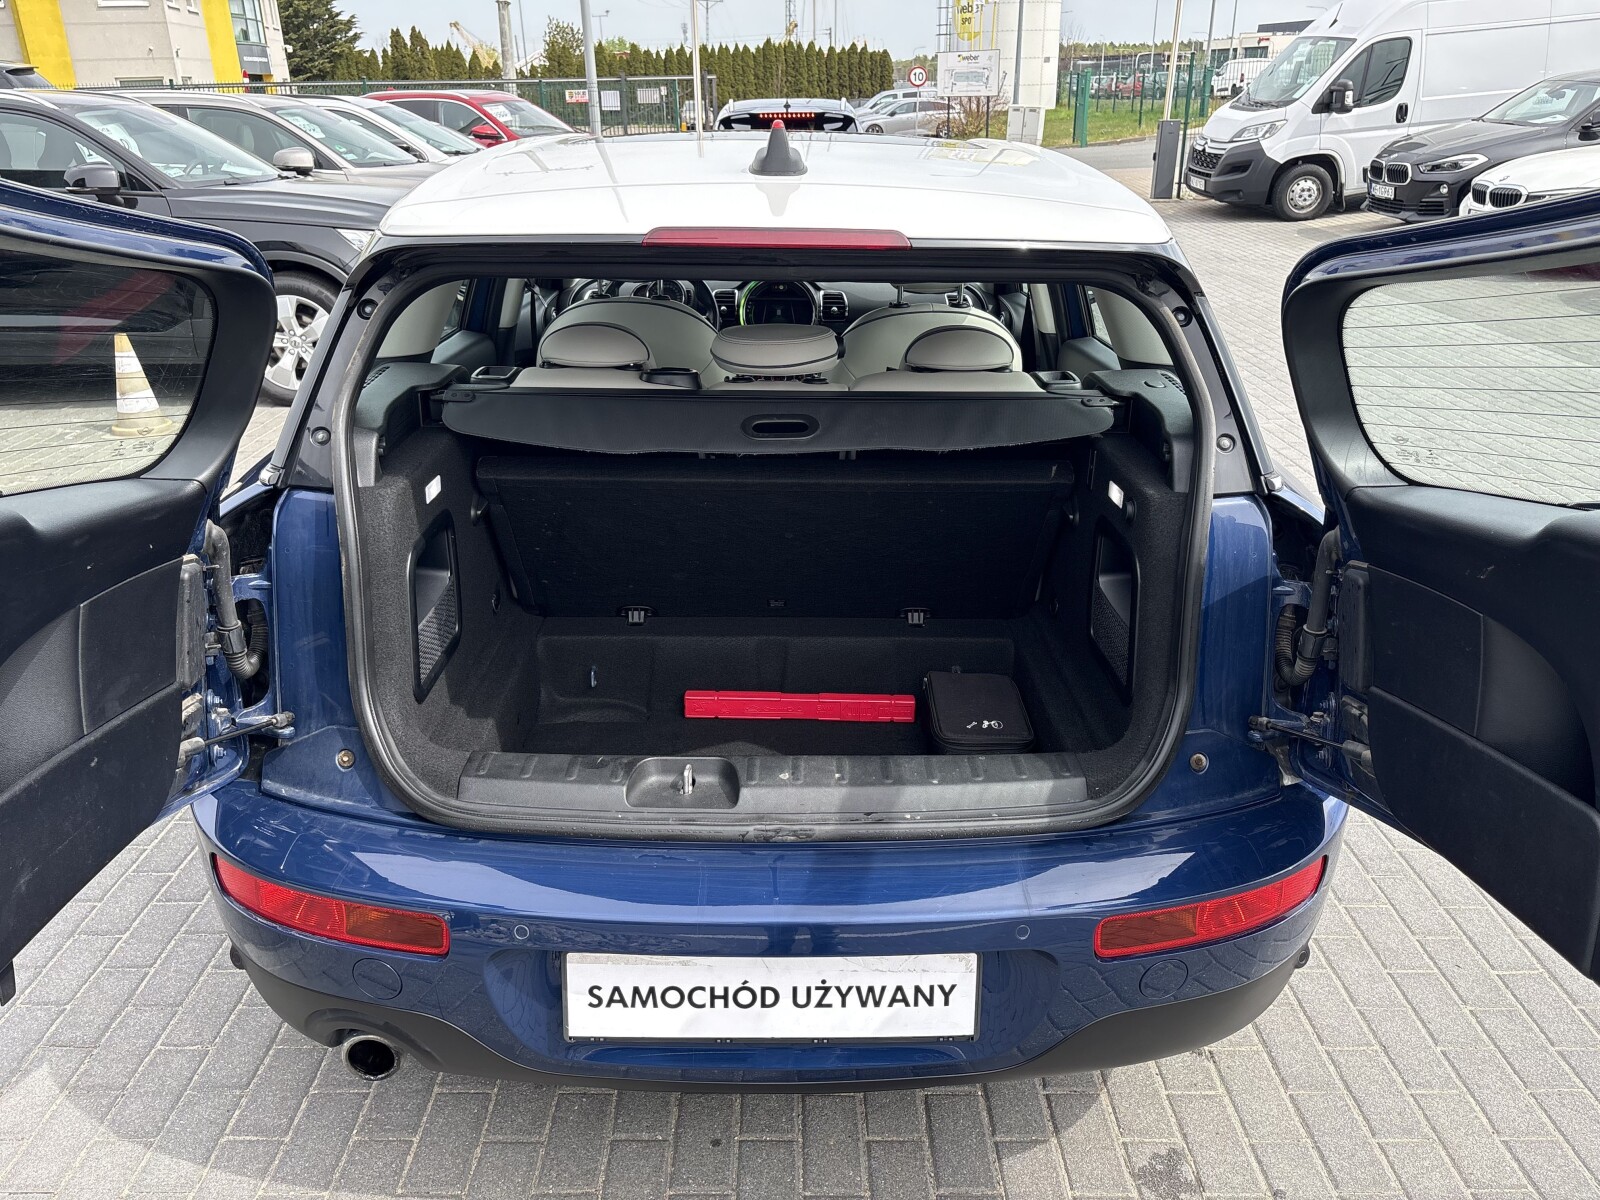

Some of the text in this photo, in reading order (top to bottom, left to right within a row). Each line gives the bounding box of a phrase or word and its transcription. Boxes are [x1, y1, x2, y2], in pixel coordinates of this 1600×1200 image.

[962, 54, 980, 62] weber
[912, 72, 924, 82] 10
[587, 978, 958, 1009] SAMOCHÓD UŻYWANY
